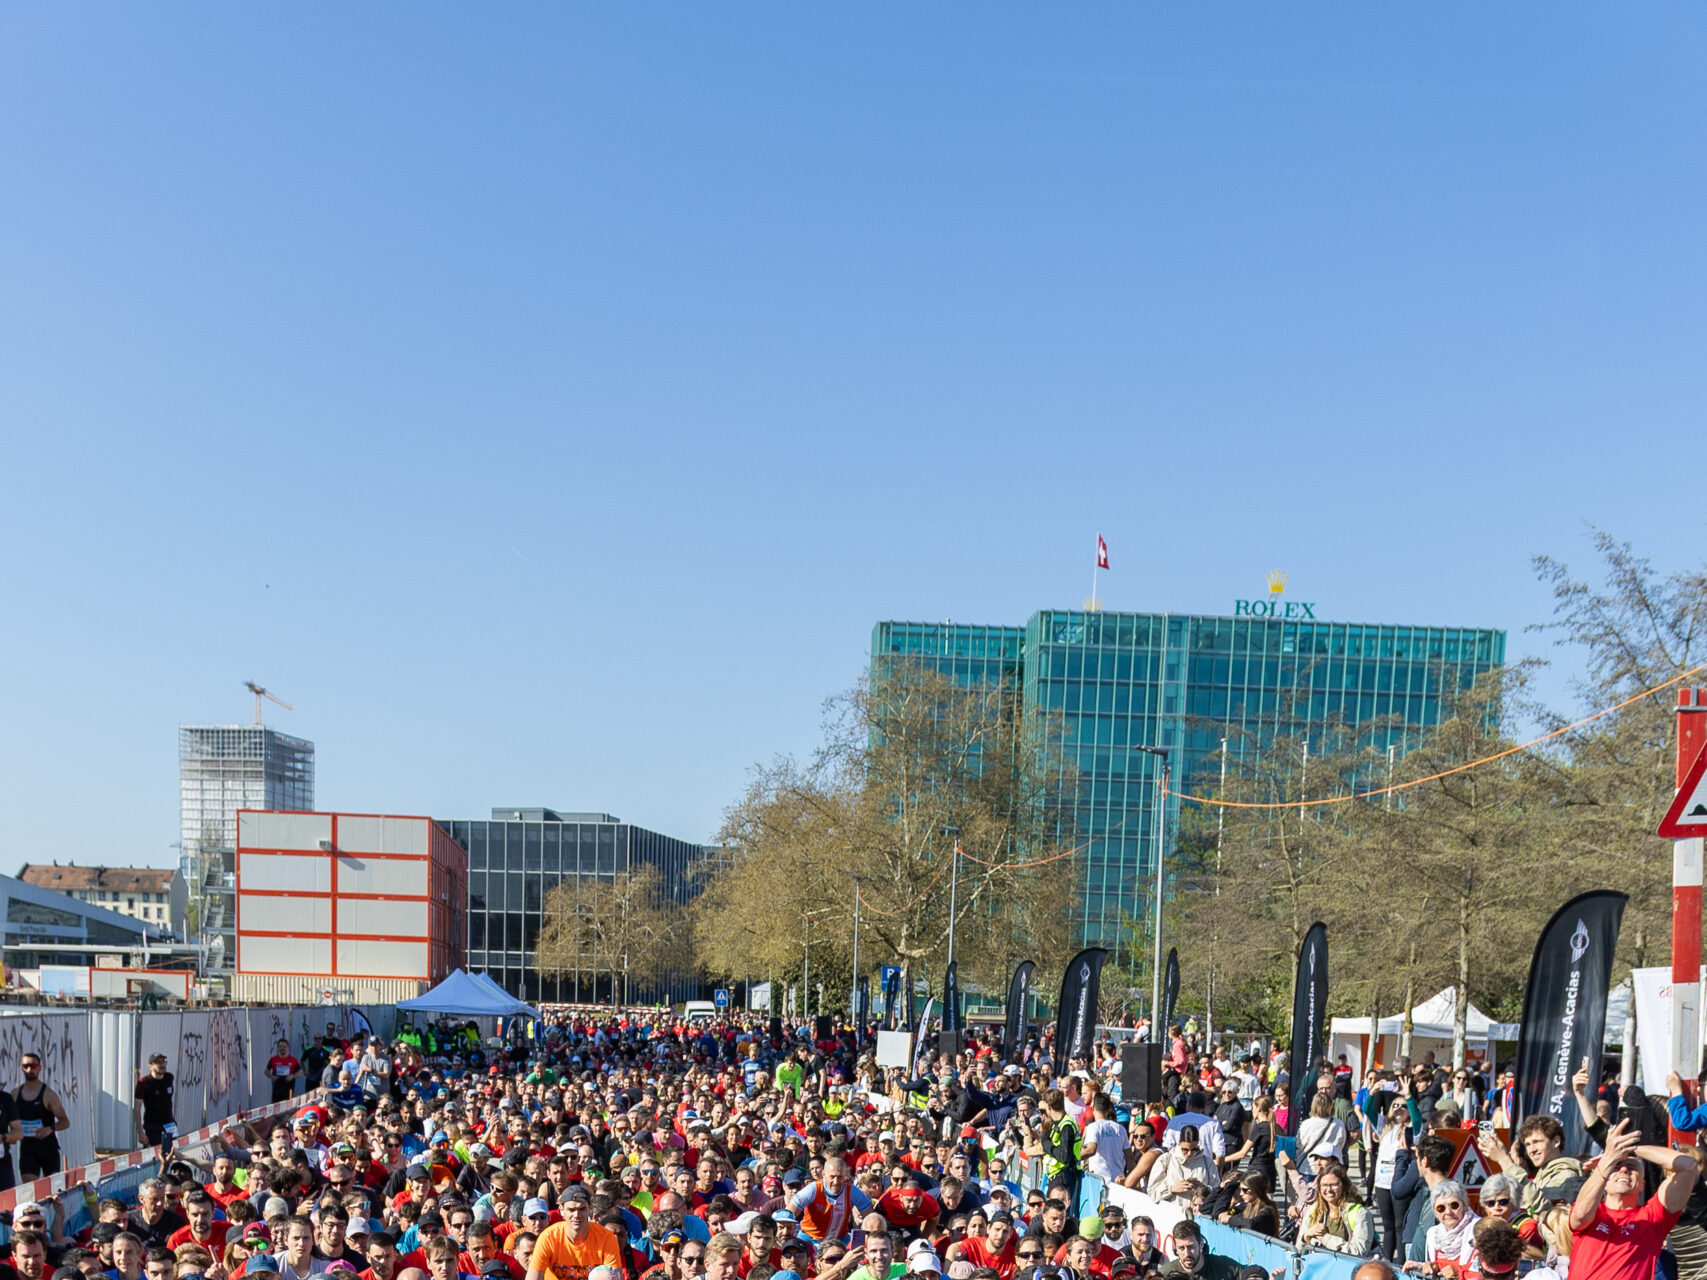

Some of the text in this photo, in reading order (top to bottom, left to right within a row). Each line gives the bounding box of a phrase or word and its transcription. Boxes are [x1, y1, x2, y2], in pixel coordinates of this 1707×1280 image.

[1235, 599, 1316, 618] ROLEX
[887, 968, 895, 979] P
[1554, 970, 1580, 1085] Genève-Acacias
